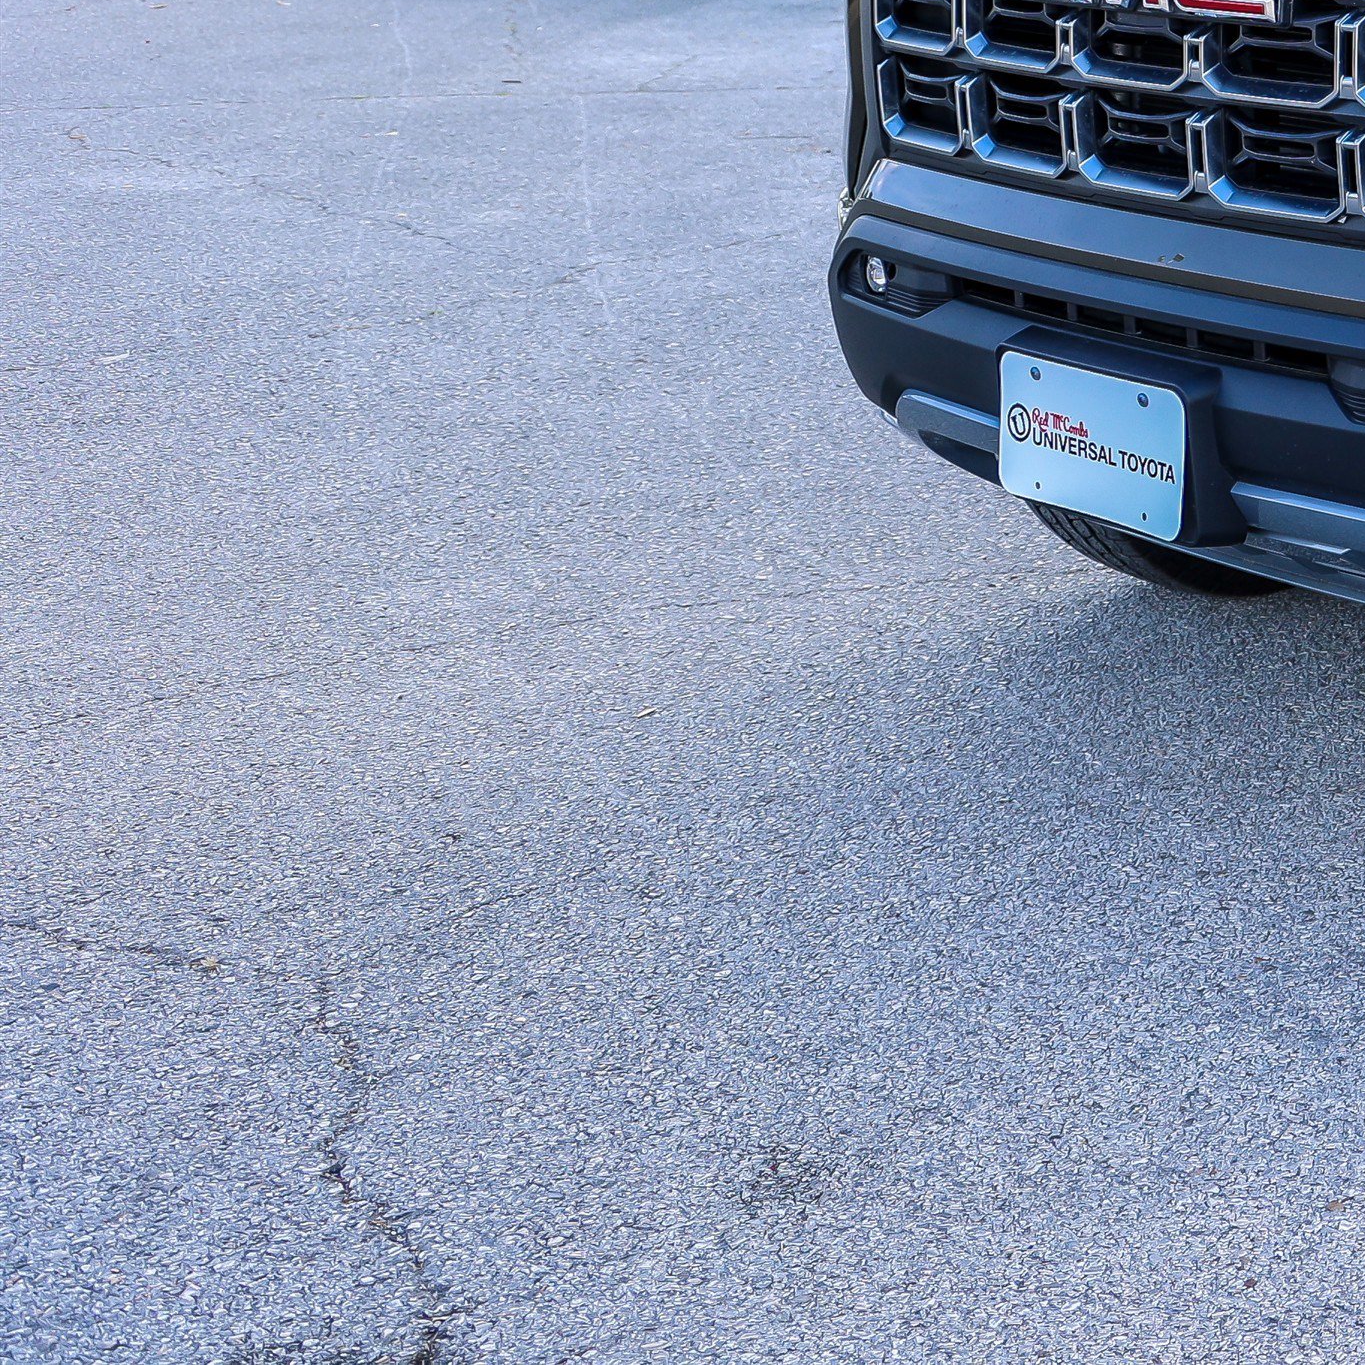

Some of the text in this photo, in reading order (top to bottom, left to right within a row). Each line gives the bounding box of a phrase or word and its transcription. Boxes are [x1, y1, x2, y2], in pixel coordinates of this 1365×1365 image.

[1032, 407, 1050, 433] Red
[1050, 412, 1089, 438] McCombs
[1032, 428, 1176, 485] UNIVERSAL TOYOTA
